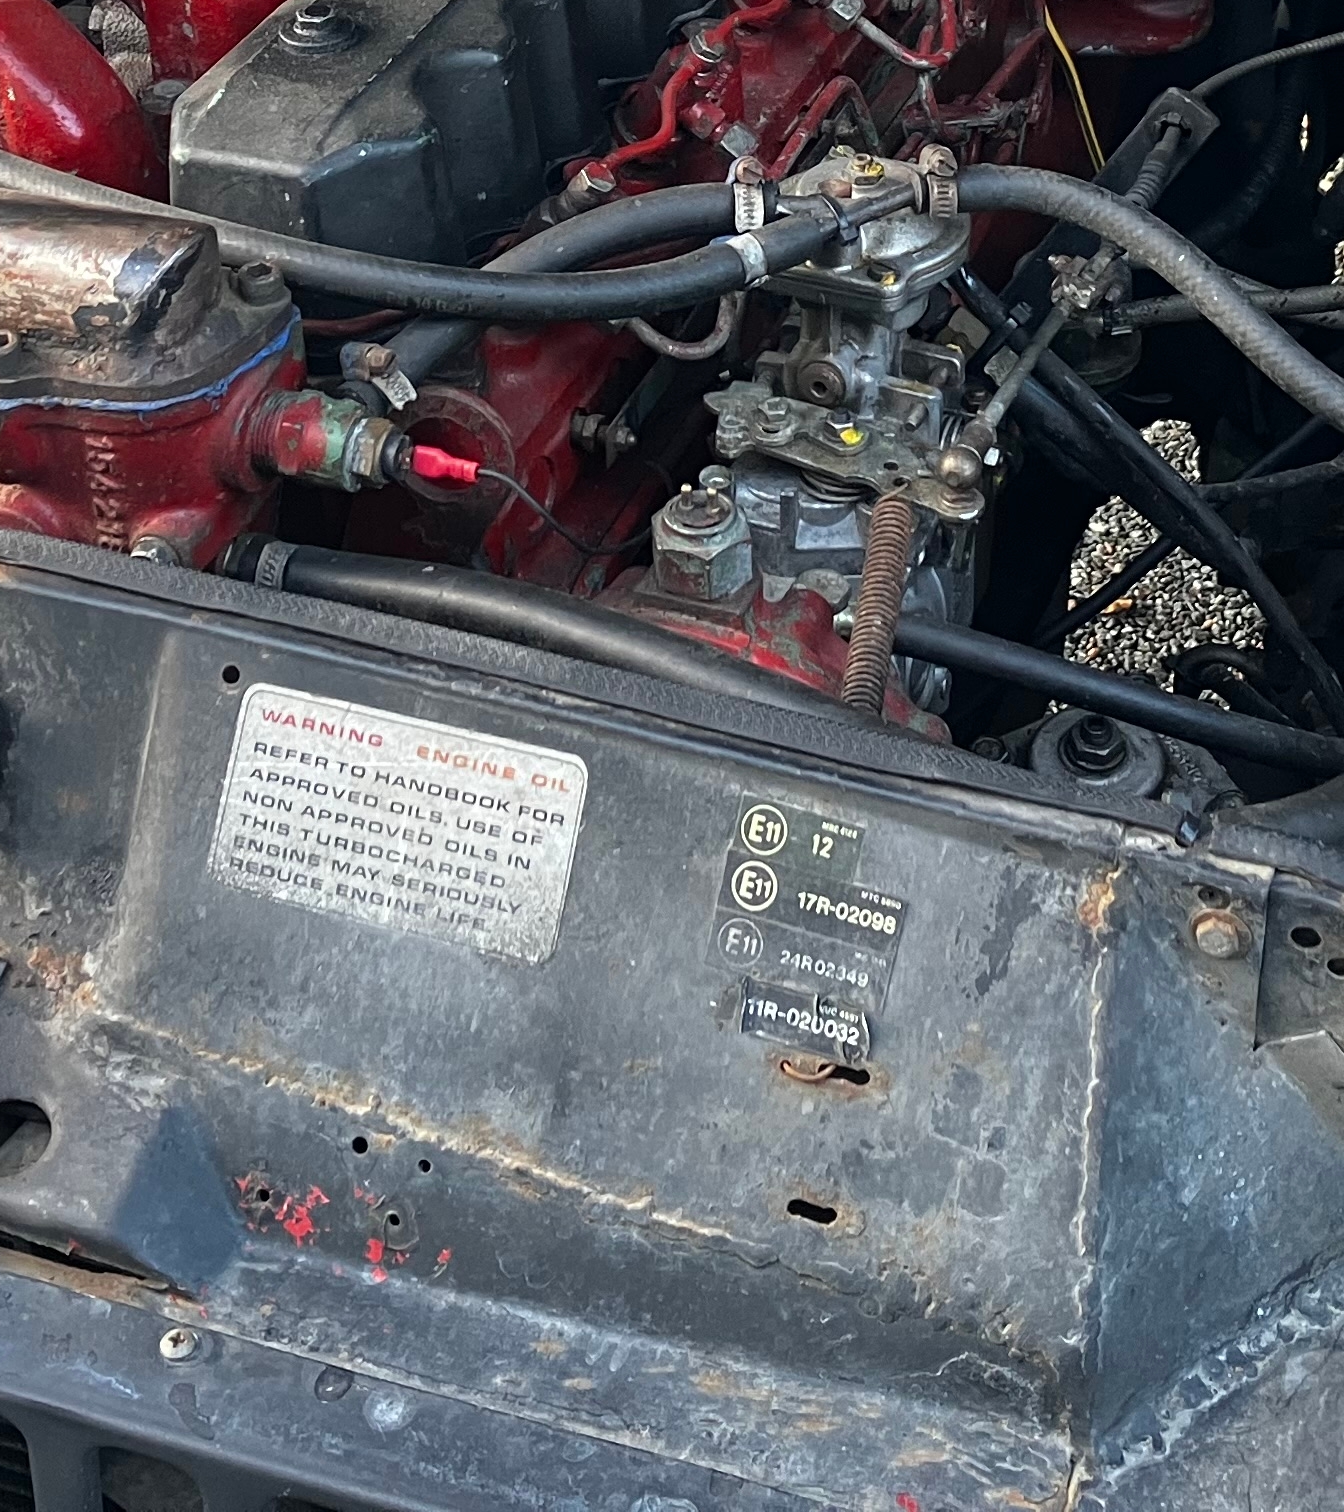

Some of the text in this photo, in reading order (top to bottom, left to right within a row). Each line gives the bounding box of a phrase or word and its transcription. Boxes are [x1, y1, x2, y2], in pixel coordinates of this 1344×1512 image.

[253, 741, 565, 827] REFER TO HANDBOOK FOR
[261, 708, 571, 793] WARNING ENGINE OIL
[243, 790, 531, 871] NON APPROVED OILS IN
[249, 768, 379, 808] APPROVED
[456, 818, 501, 838] USE
[512, 830, 544, 847] OF
[748, 813, 781, 844] E11
[812, 833, 834, 859] 12
[229, 856, 325, 891] REDUCE
[335, 882, 427, 918] ENGINE
[233, 835, 523, 916] ENGINE MAY SERIOUSLY
[239, 812, 506, 889] THIS TURBOCHARGED
[739, 869, 772, 900] E11
[798, 891, 897, 935] 17R-02098
